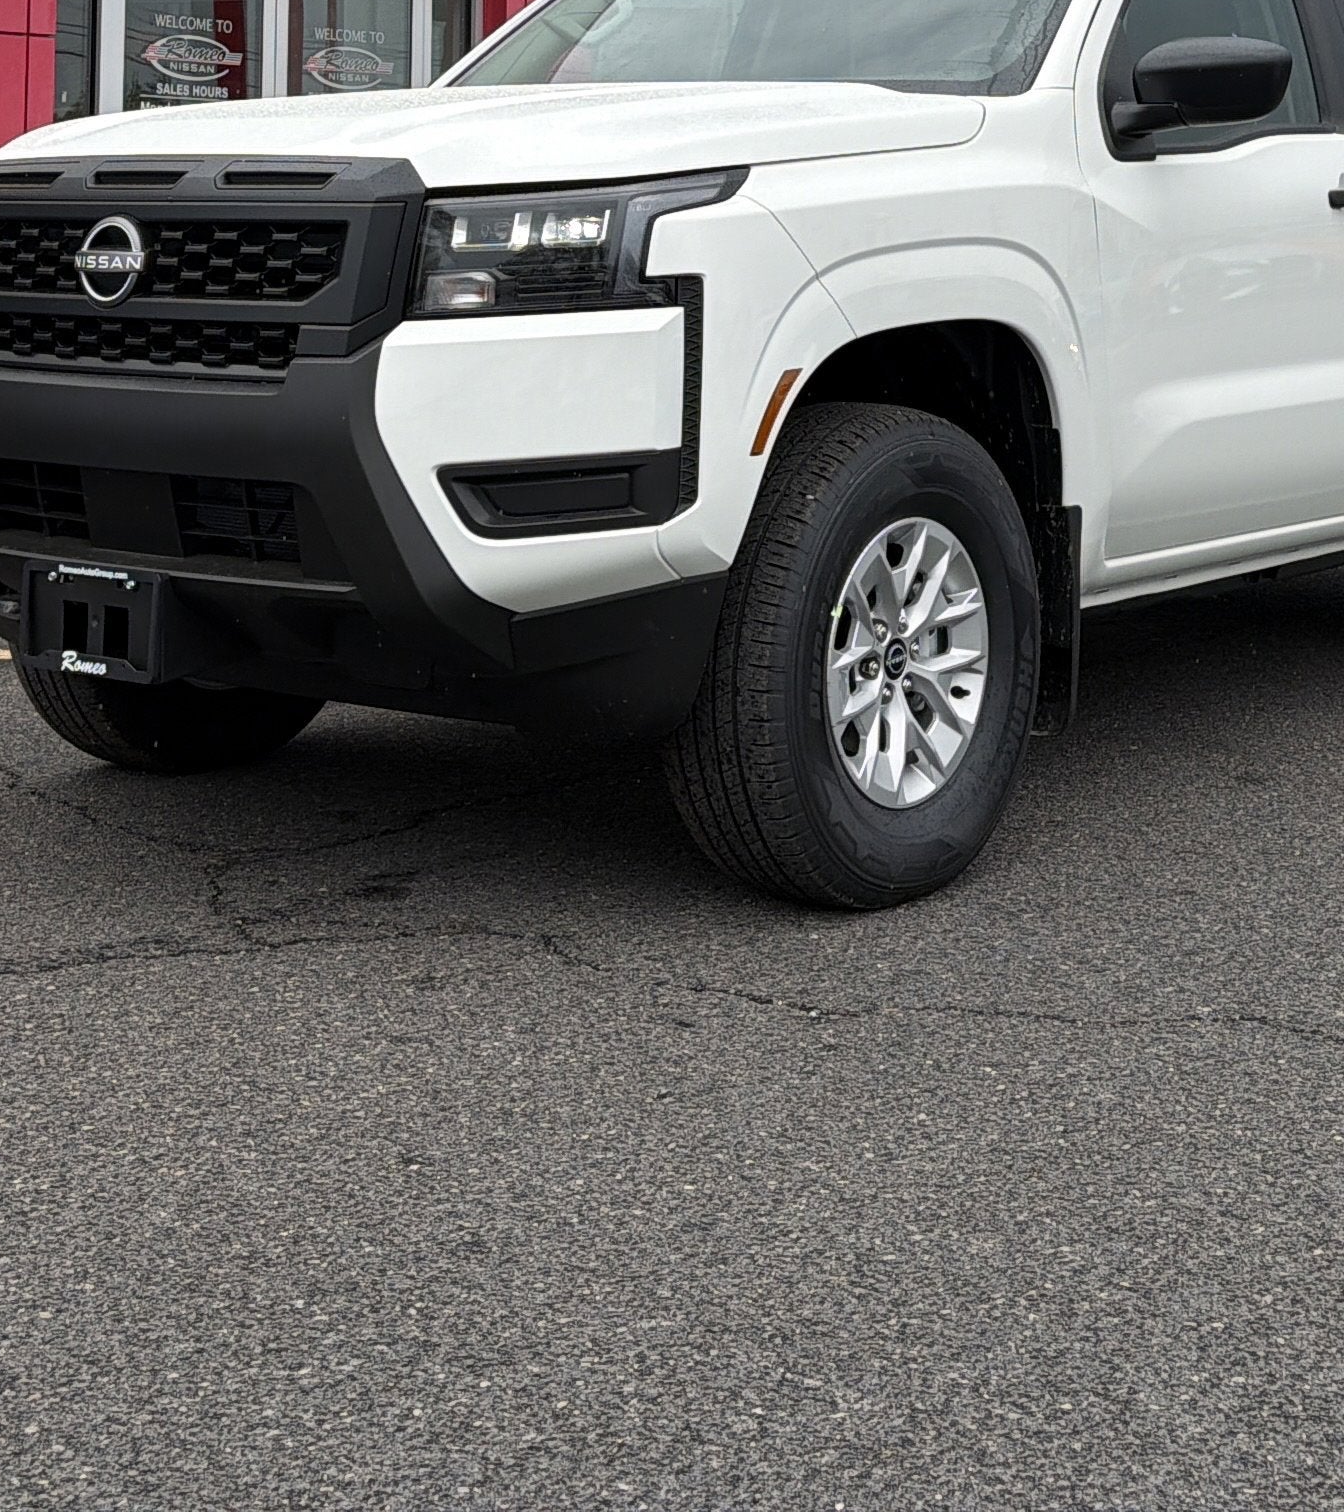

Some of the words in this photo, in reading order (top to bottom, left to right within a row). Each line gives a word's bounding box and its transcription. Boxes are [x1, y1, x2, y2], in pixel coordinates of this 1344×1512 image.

[154, 14, 213, 32] WELCOME
[216, 19, 233, 34] TO
[314, 27, 367, 43] WELCOME
[369, 31, 385, 44] TO
[160, 37, 227, 62] Romeo
[169, 62, 215, 74] NISSAN
[320, 49, 379, 72] Romeo
[328, 72, 369, 83] NISSAN
[156, 82, 190, 96] SALES
[192, 85, 229, 99] HOURS
[75, 255, 142, 270] NISSAN
[60, 650, 107, 676] Romeo
